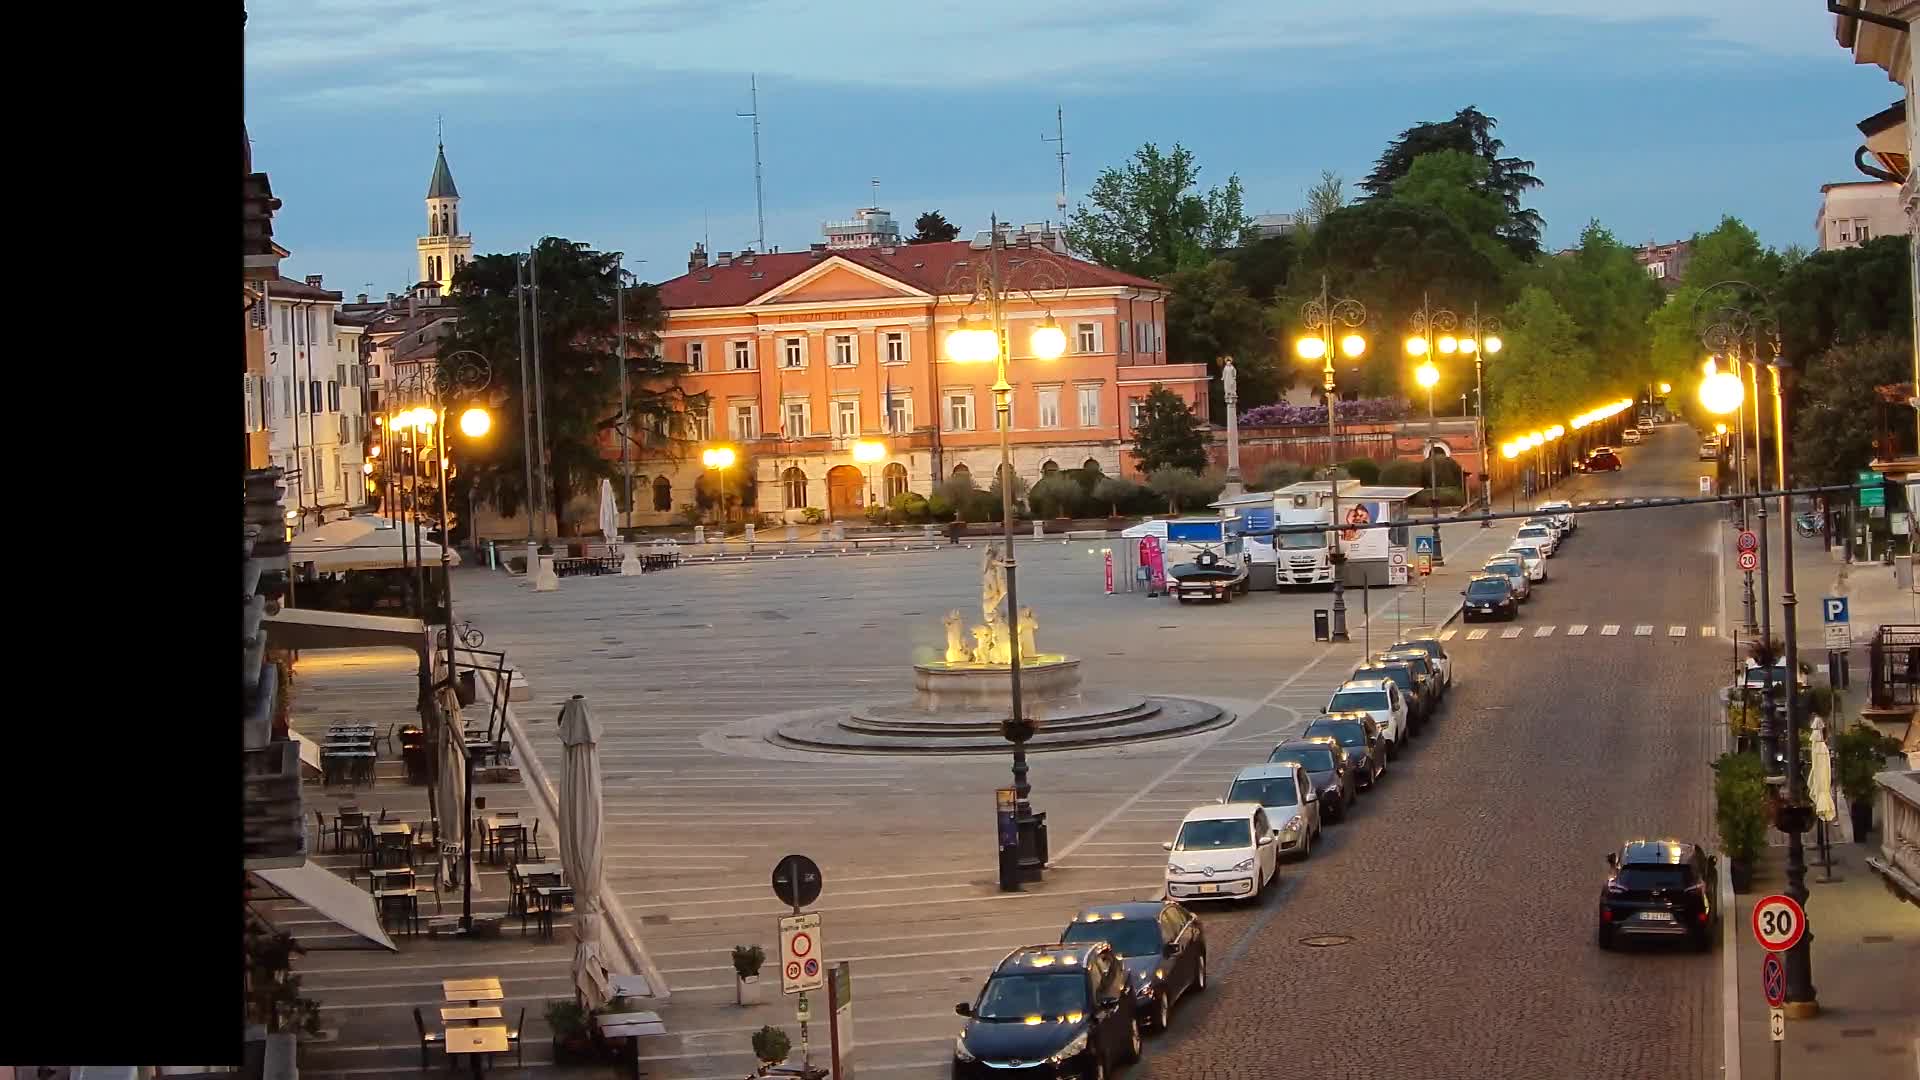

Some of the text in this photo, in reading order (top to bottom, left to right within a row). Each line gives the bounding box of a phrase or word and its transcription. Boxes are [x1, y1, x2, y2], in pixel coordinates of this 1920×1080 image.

[1743, 556, 1754, 566] 20
[1828, 600, 1844, 621] P
[1763, 910, 1792, 936] 30
[790, 967, 798, 976] 20
